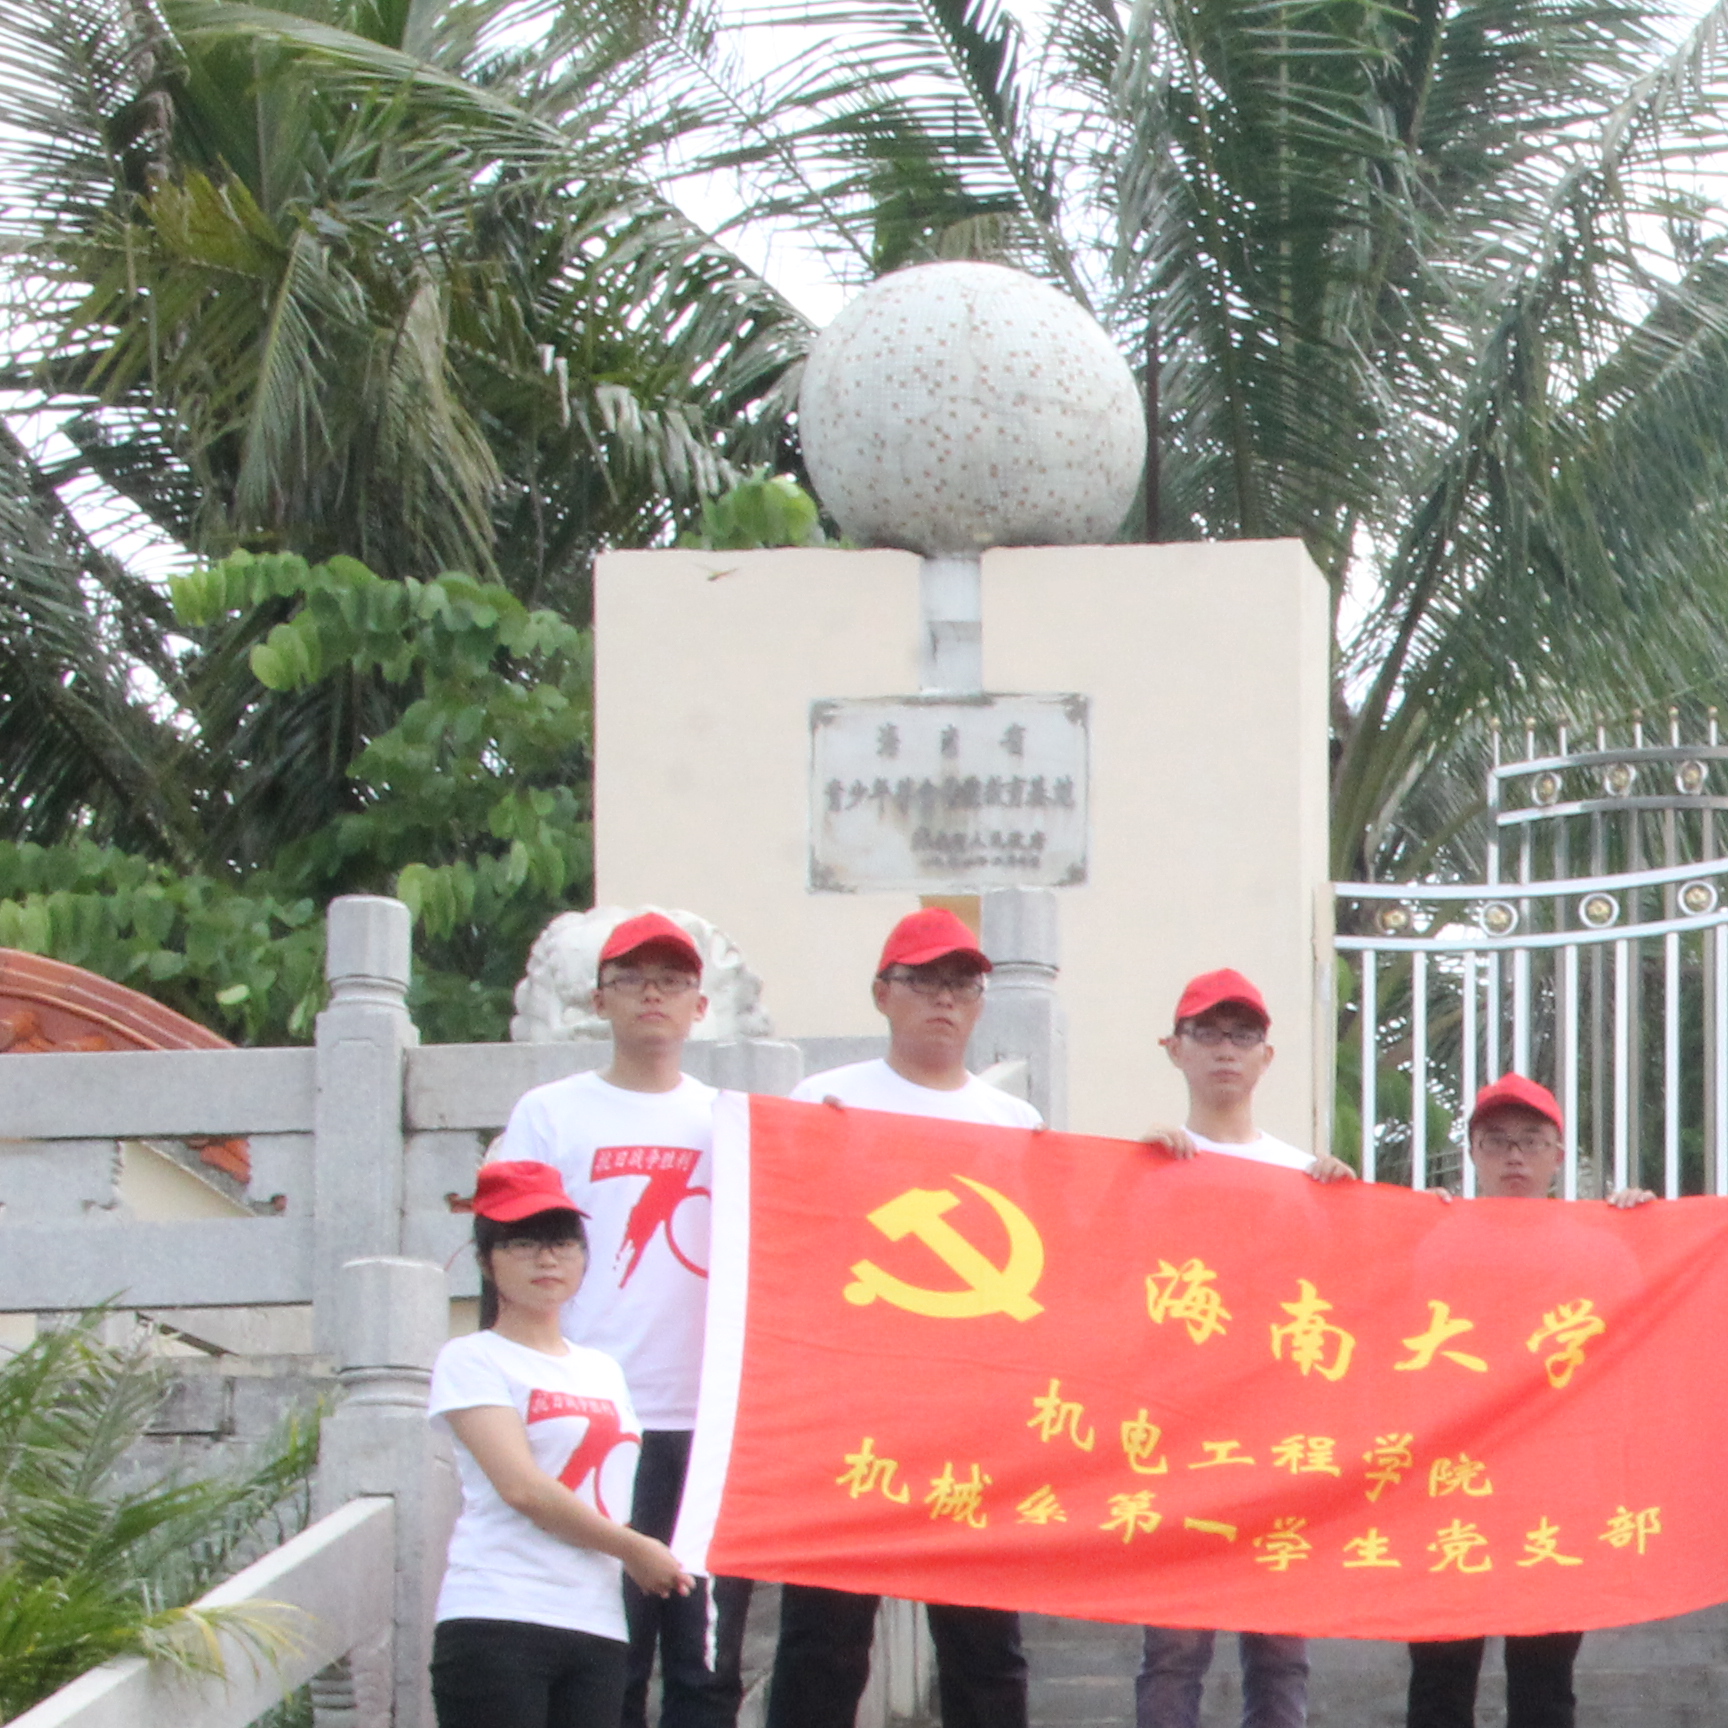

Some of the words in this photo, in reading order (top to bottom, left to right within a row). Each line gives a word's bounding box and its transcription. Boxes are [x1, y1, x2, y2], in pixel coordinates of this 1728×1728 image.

[1145, 1257, 1606, 1389] 海南大学
[836, 1437, 1663, 1574] 机械系第一学生党支部
[1026, 1378, 1494, 1502] 机电工程学院
